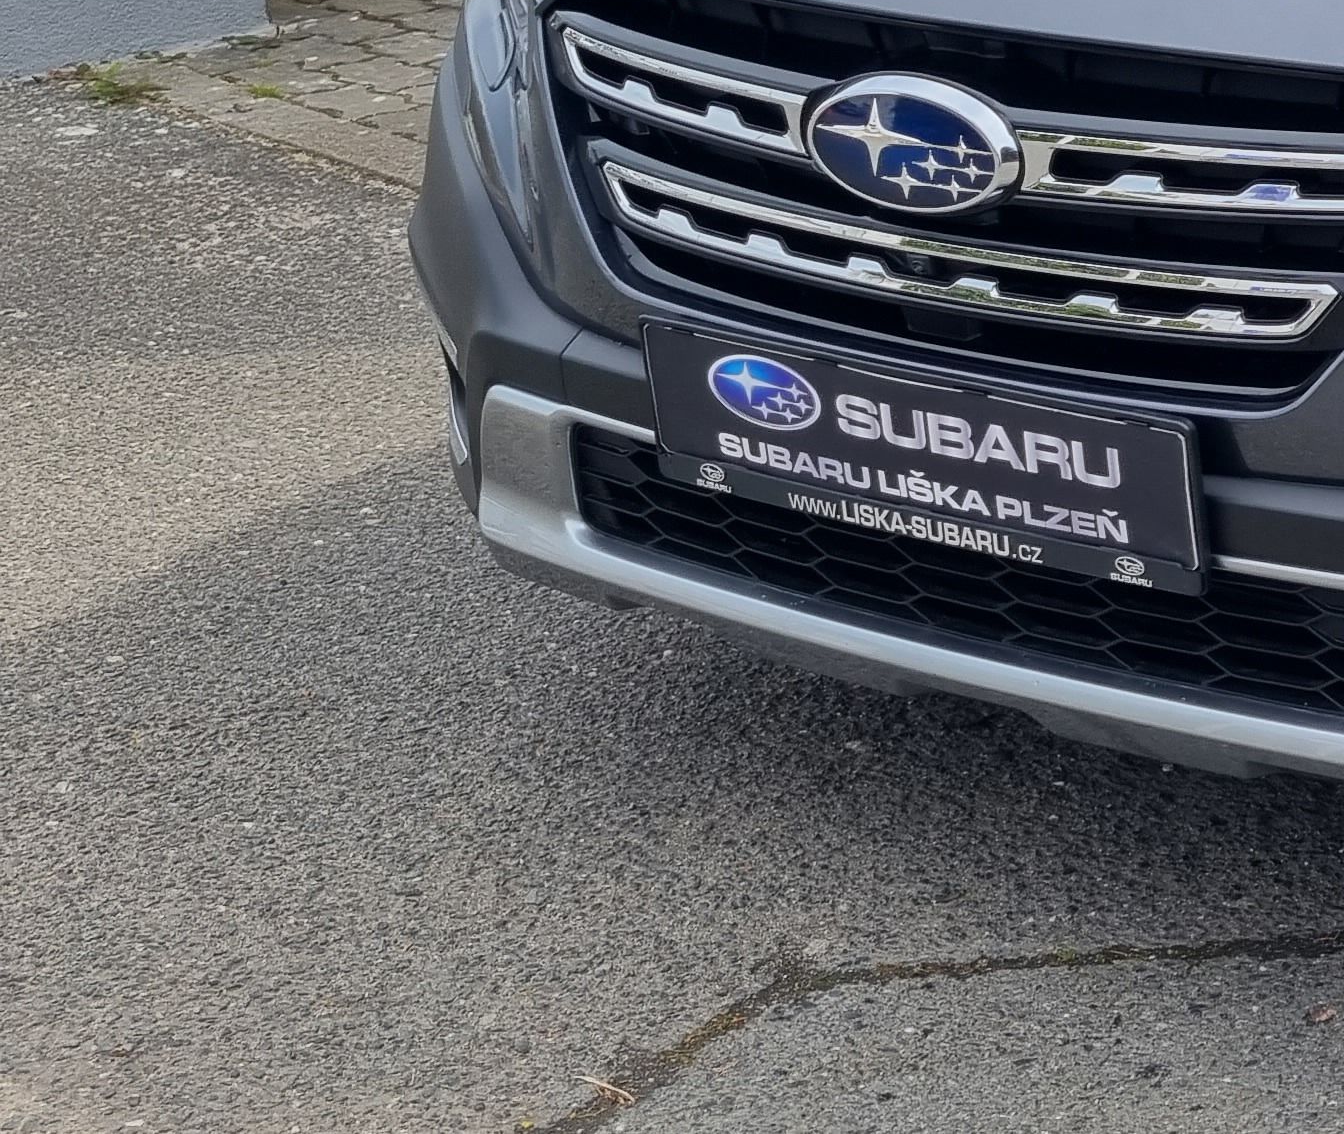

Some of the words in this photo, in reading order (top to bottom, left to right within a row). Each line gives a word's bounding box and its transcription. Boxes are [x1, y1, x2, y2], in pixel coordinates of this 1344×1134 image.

[835, 393, 1122, 489] SUBARU
[696, 479, 732, 494] SUBARU
[717, 432, 871, 489] SUBARU
[877, 470, 988, 517] LIŠKA
[996, 495, 1129, 544] PLZEŇ
[1110, 572, 1154, 588] SUBARU
